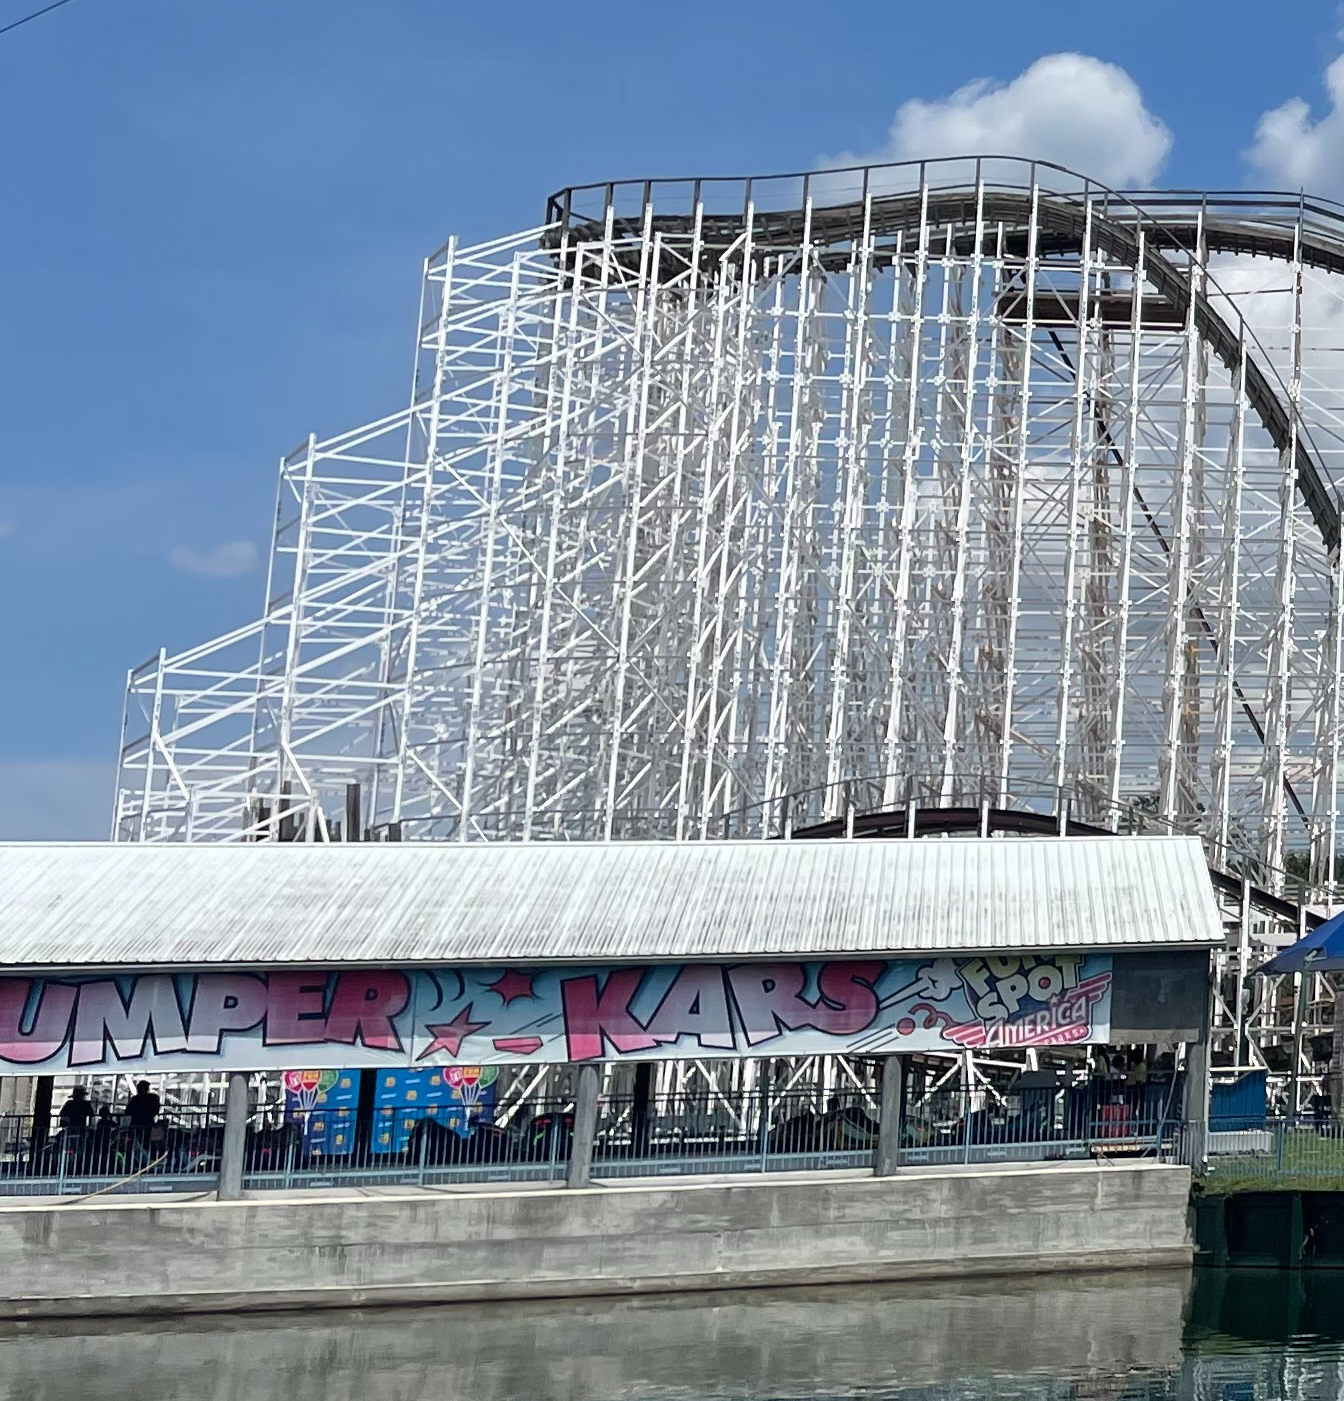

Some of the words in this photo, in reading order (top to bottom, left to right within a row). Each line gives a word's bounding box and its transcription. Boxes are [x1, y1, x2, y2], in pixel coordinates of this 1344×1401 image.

[0, 969, 411, 1067] UMPER
[560, 960, 880, 1062] KARS
[976, 955, 1082, 1021] SPOT
[984, 996, 1087, 1047] AMERICA
